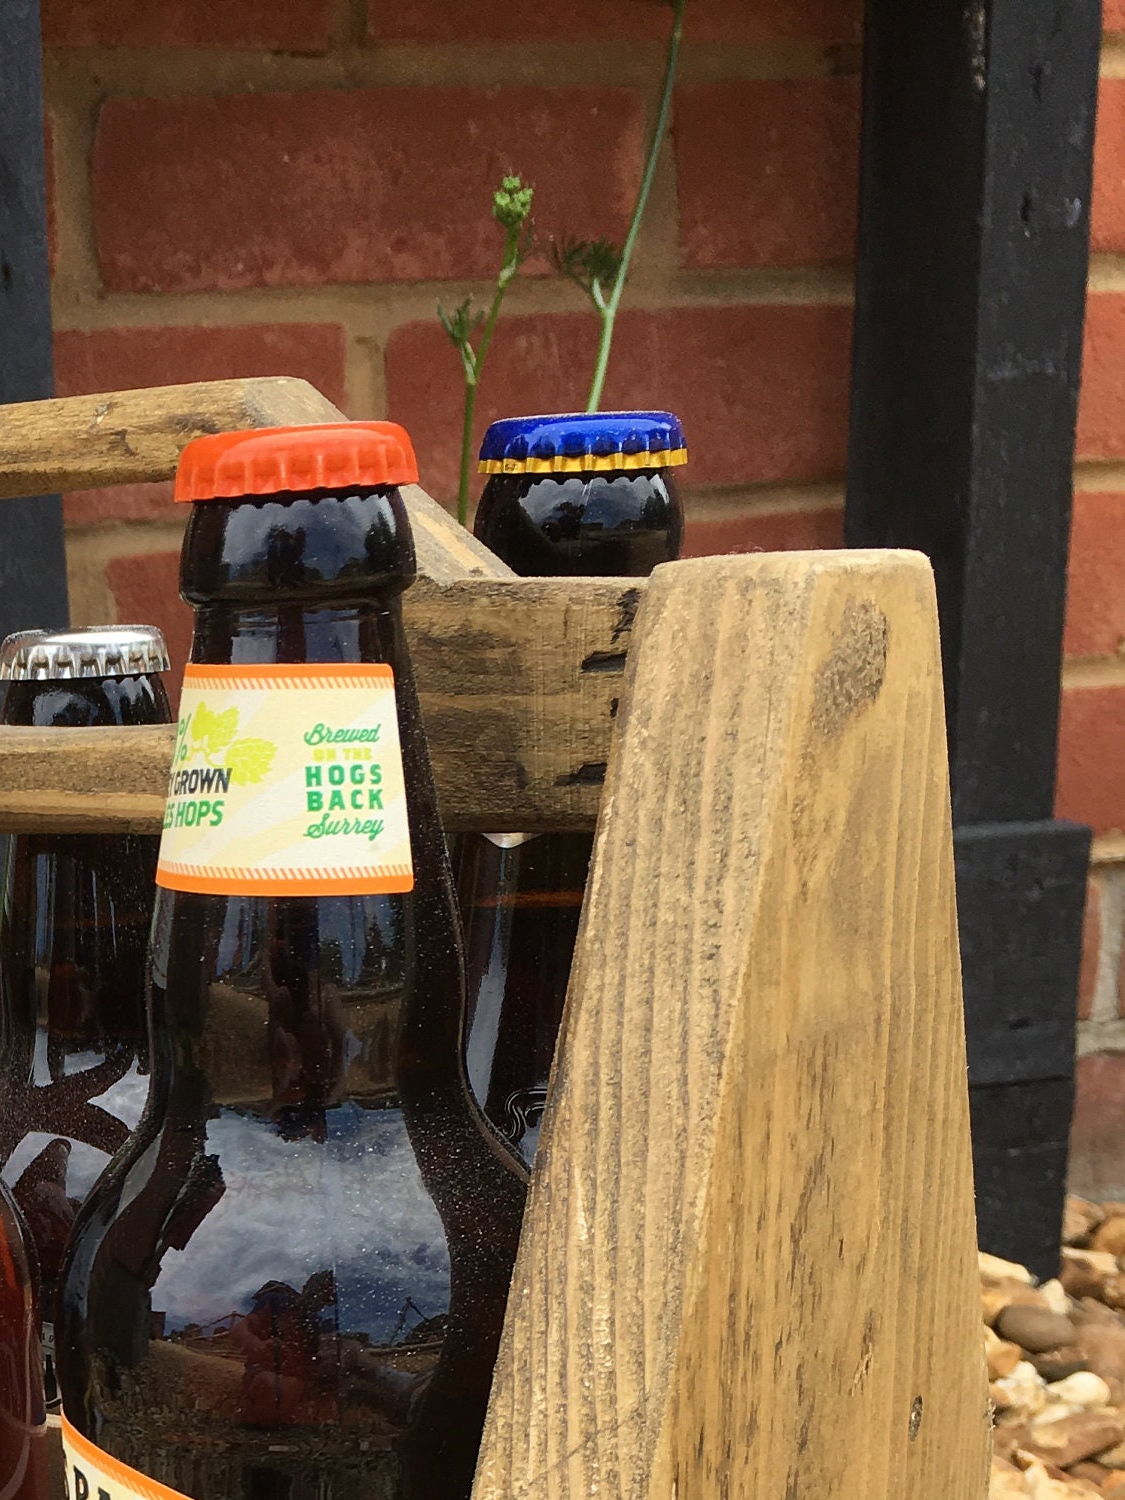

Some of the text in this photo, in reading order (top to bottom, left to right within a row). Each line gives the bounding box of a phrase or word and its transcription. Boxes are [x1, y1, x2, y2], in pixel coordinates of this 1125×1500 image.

[303, 722, 382, 746] Brewed
[305, 764, 382, 787] HOGS
[306, 788, 384, 812] BACK
[175, 800, 225, 828] HOPS
[303, 812, 384, 841] Surrey
